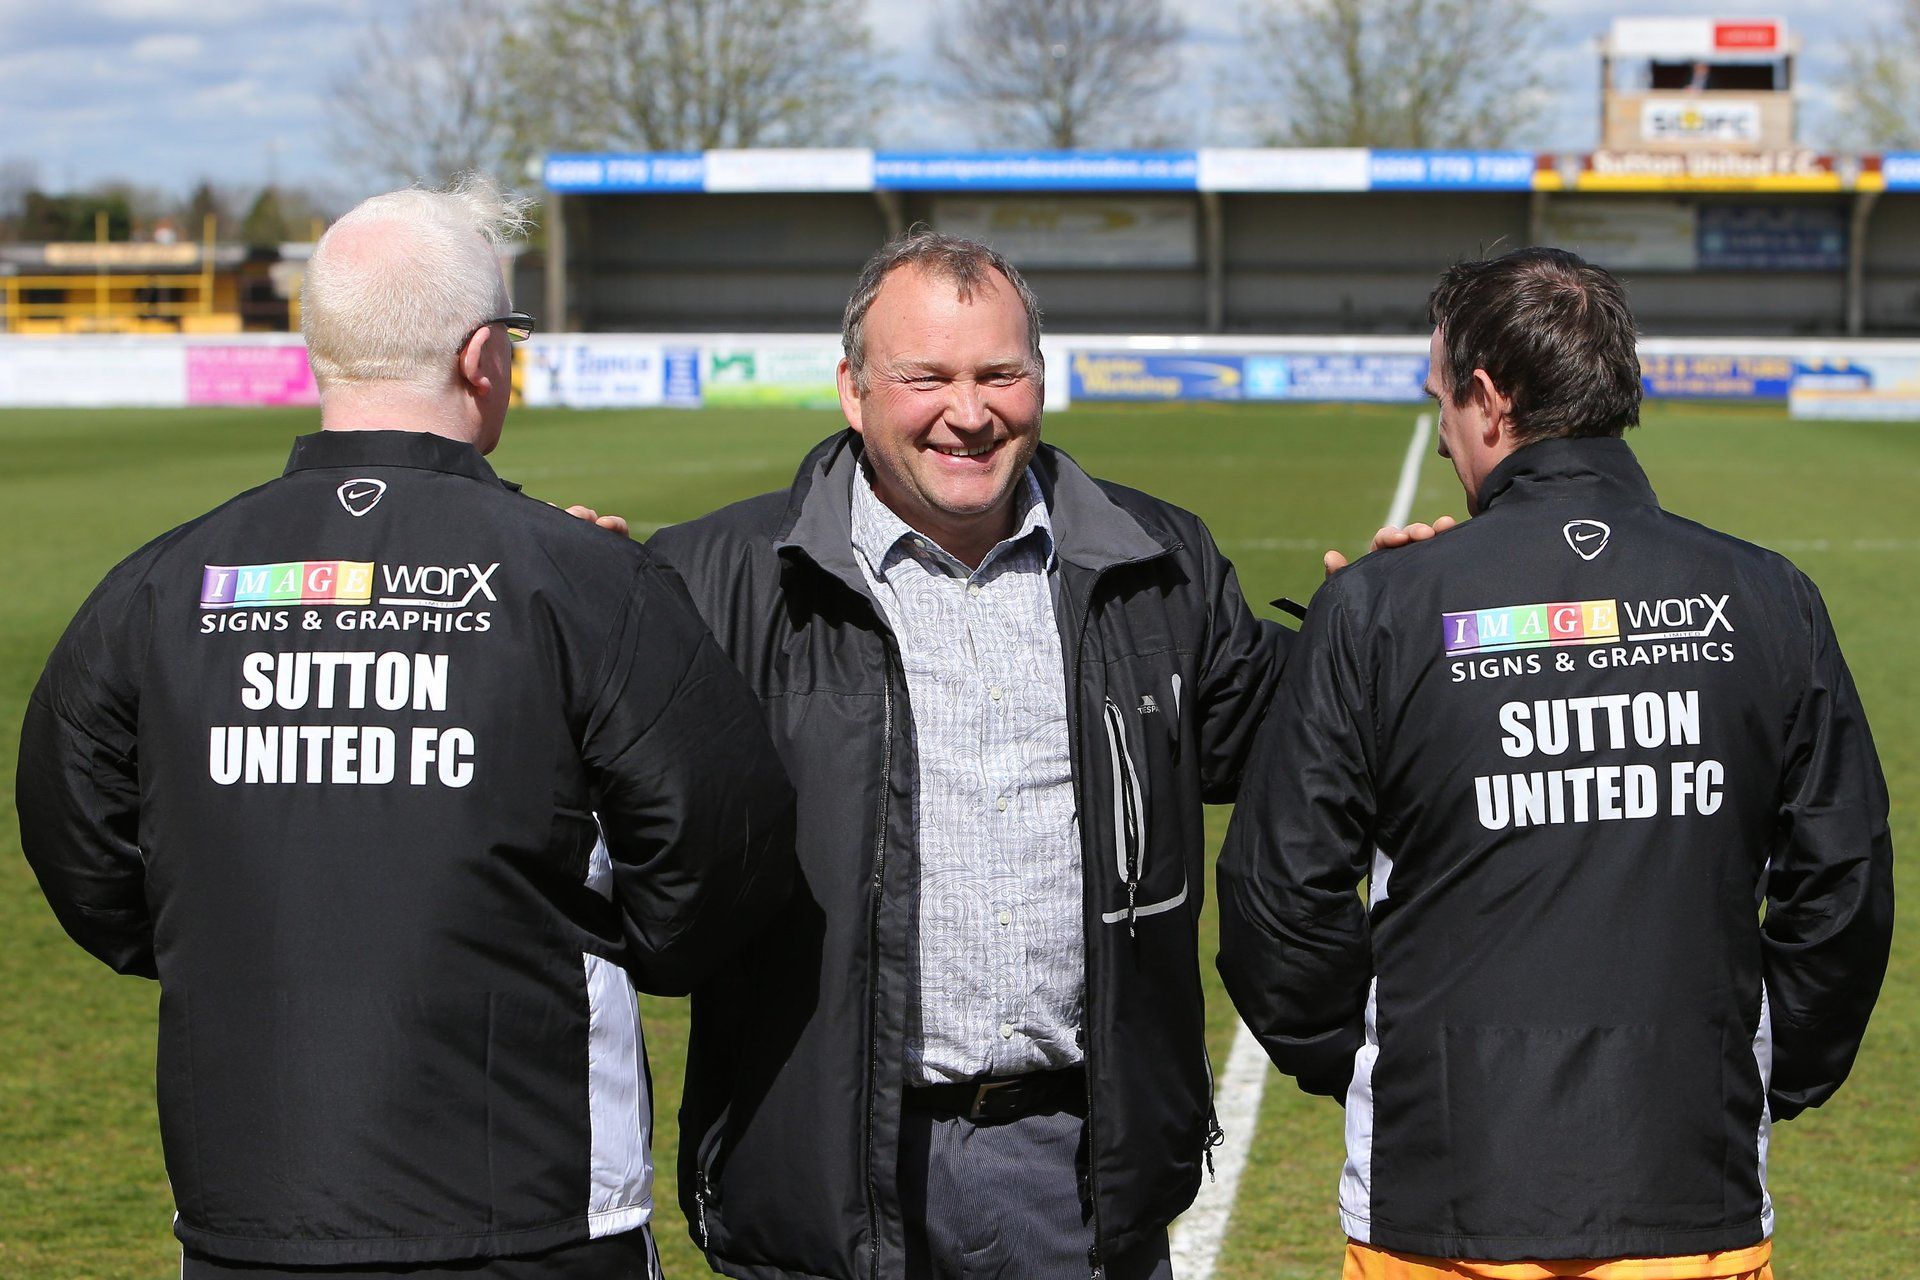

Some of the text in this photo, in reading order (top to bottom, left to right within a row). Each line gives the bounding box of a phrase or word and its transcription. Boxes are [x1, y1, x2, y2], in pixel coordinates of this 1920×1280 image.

[207, 565, 371, 599] IMAGE
[200, 610, 492, 633] SIGNS & GRAPHICS
[1450, 603, 1616, 646] IMAGE
[241, 650, 449, 711] SUTTON
[1451, 641, 1735, 682] SIGNS & GRAPHICS
[1499, 690, 1701, 758] SUTTON
[209, 725, 475, 788] UNITED FC
[1474, 759, 1725, 830] UNITED FC
